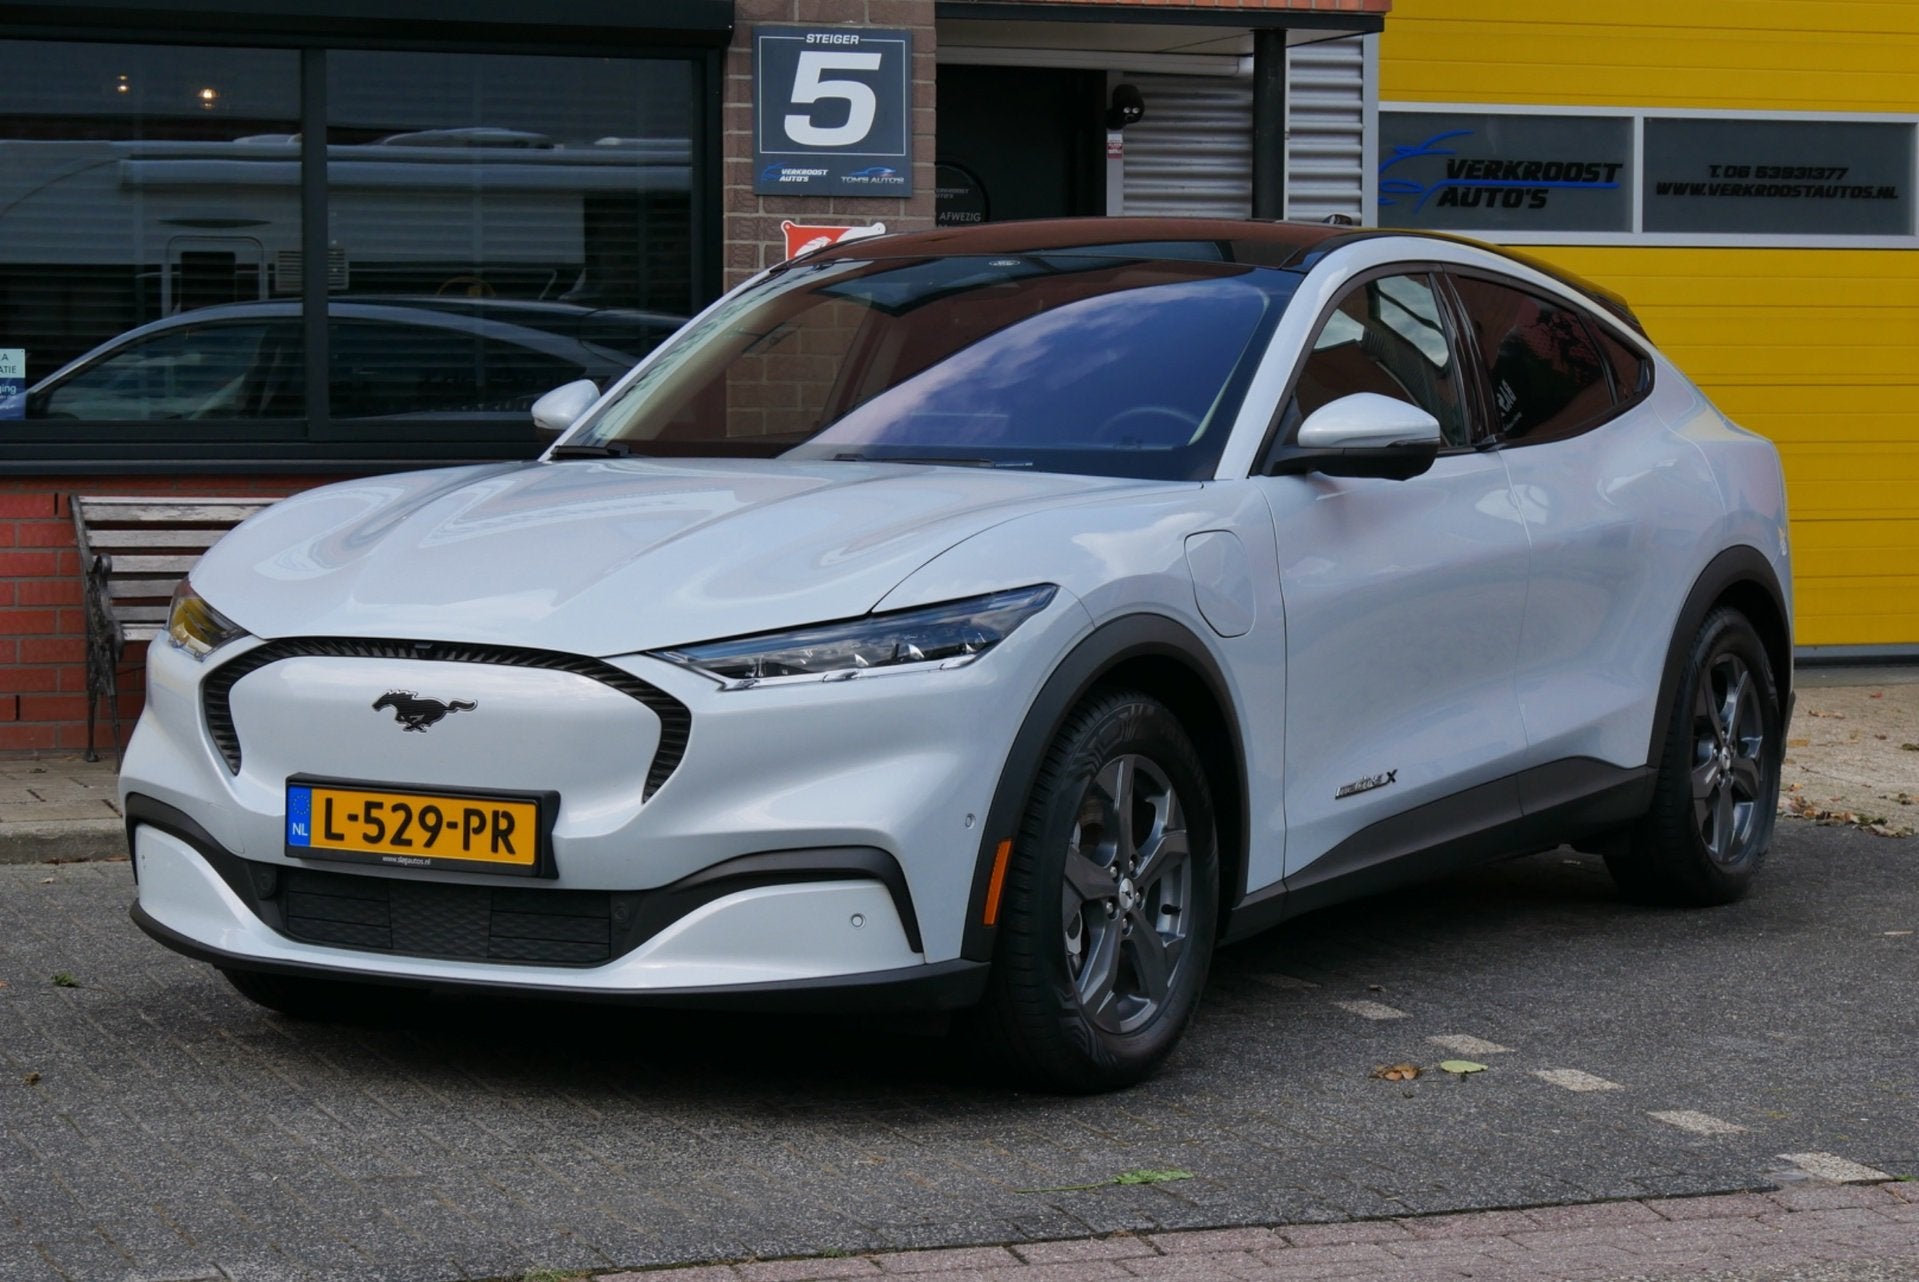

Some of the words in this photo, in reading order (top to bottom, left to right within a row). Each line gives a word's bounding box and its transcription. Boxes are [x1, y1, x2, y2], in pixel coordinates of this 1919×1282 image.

[806, 33, 859, 45] STEIGER
[784, 51, 882, 146] 5
[1445, 159, 1622, 184] VERKROOST
[1437, 187, 1548, 209] AUTO'S
[1656, 182, 1898, 200] WWW.VERKROOSTAUTOS.NL
[939, 212, 981, 222] AFWEZIG
[0, 384, 16, 395] ing
[292, 822, 308, 836] NL
[324, 797, 516, 855] L-529-PR
